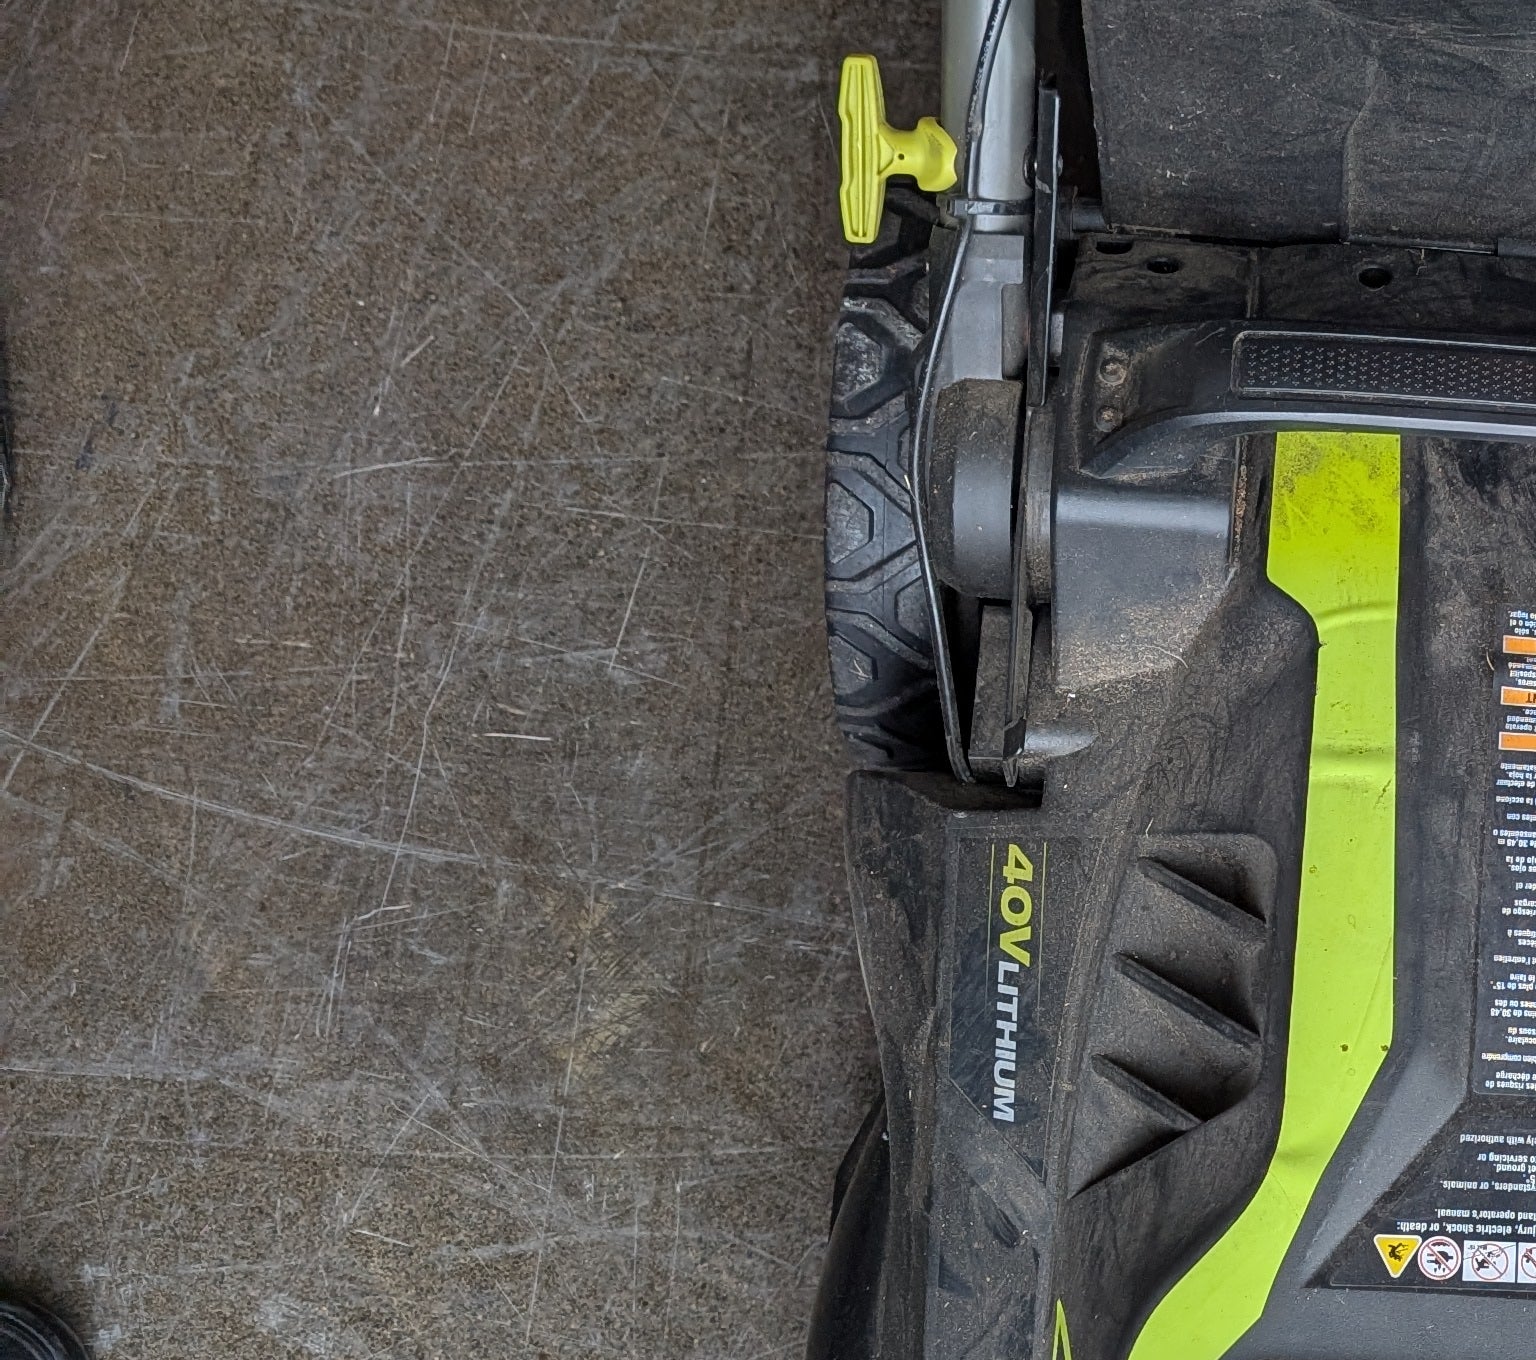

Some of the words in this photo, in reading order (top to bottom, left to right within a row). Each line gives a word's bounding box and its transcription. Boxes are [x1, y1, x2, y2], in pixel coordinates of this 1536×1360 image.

[1000, 844, 1034, 967] 40V
[993, 961, 1019, 1122] LITHIUM
[1459, 1133, 1504, 1144] authorized
[1506, 1136, 1524, 1145] with
[1488, 1152, 1528, 1164] servicing
[1395, 1221, 1427, 1232] death:
[1428, 1222, 1439, 1231] or
[1442, 1222, 1473, 1234] shock,
[1475, 1224, 1512, 1236] electric
